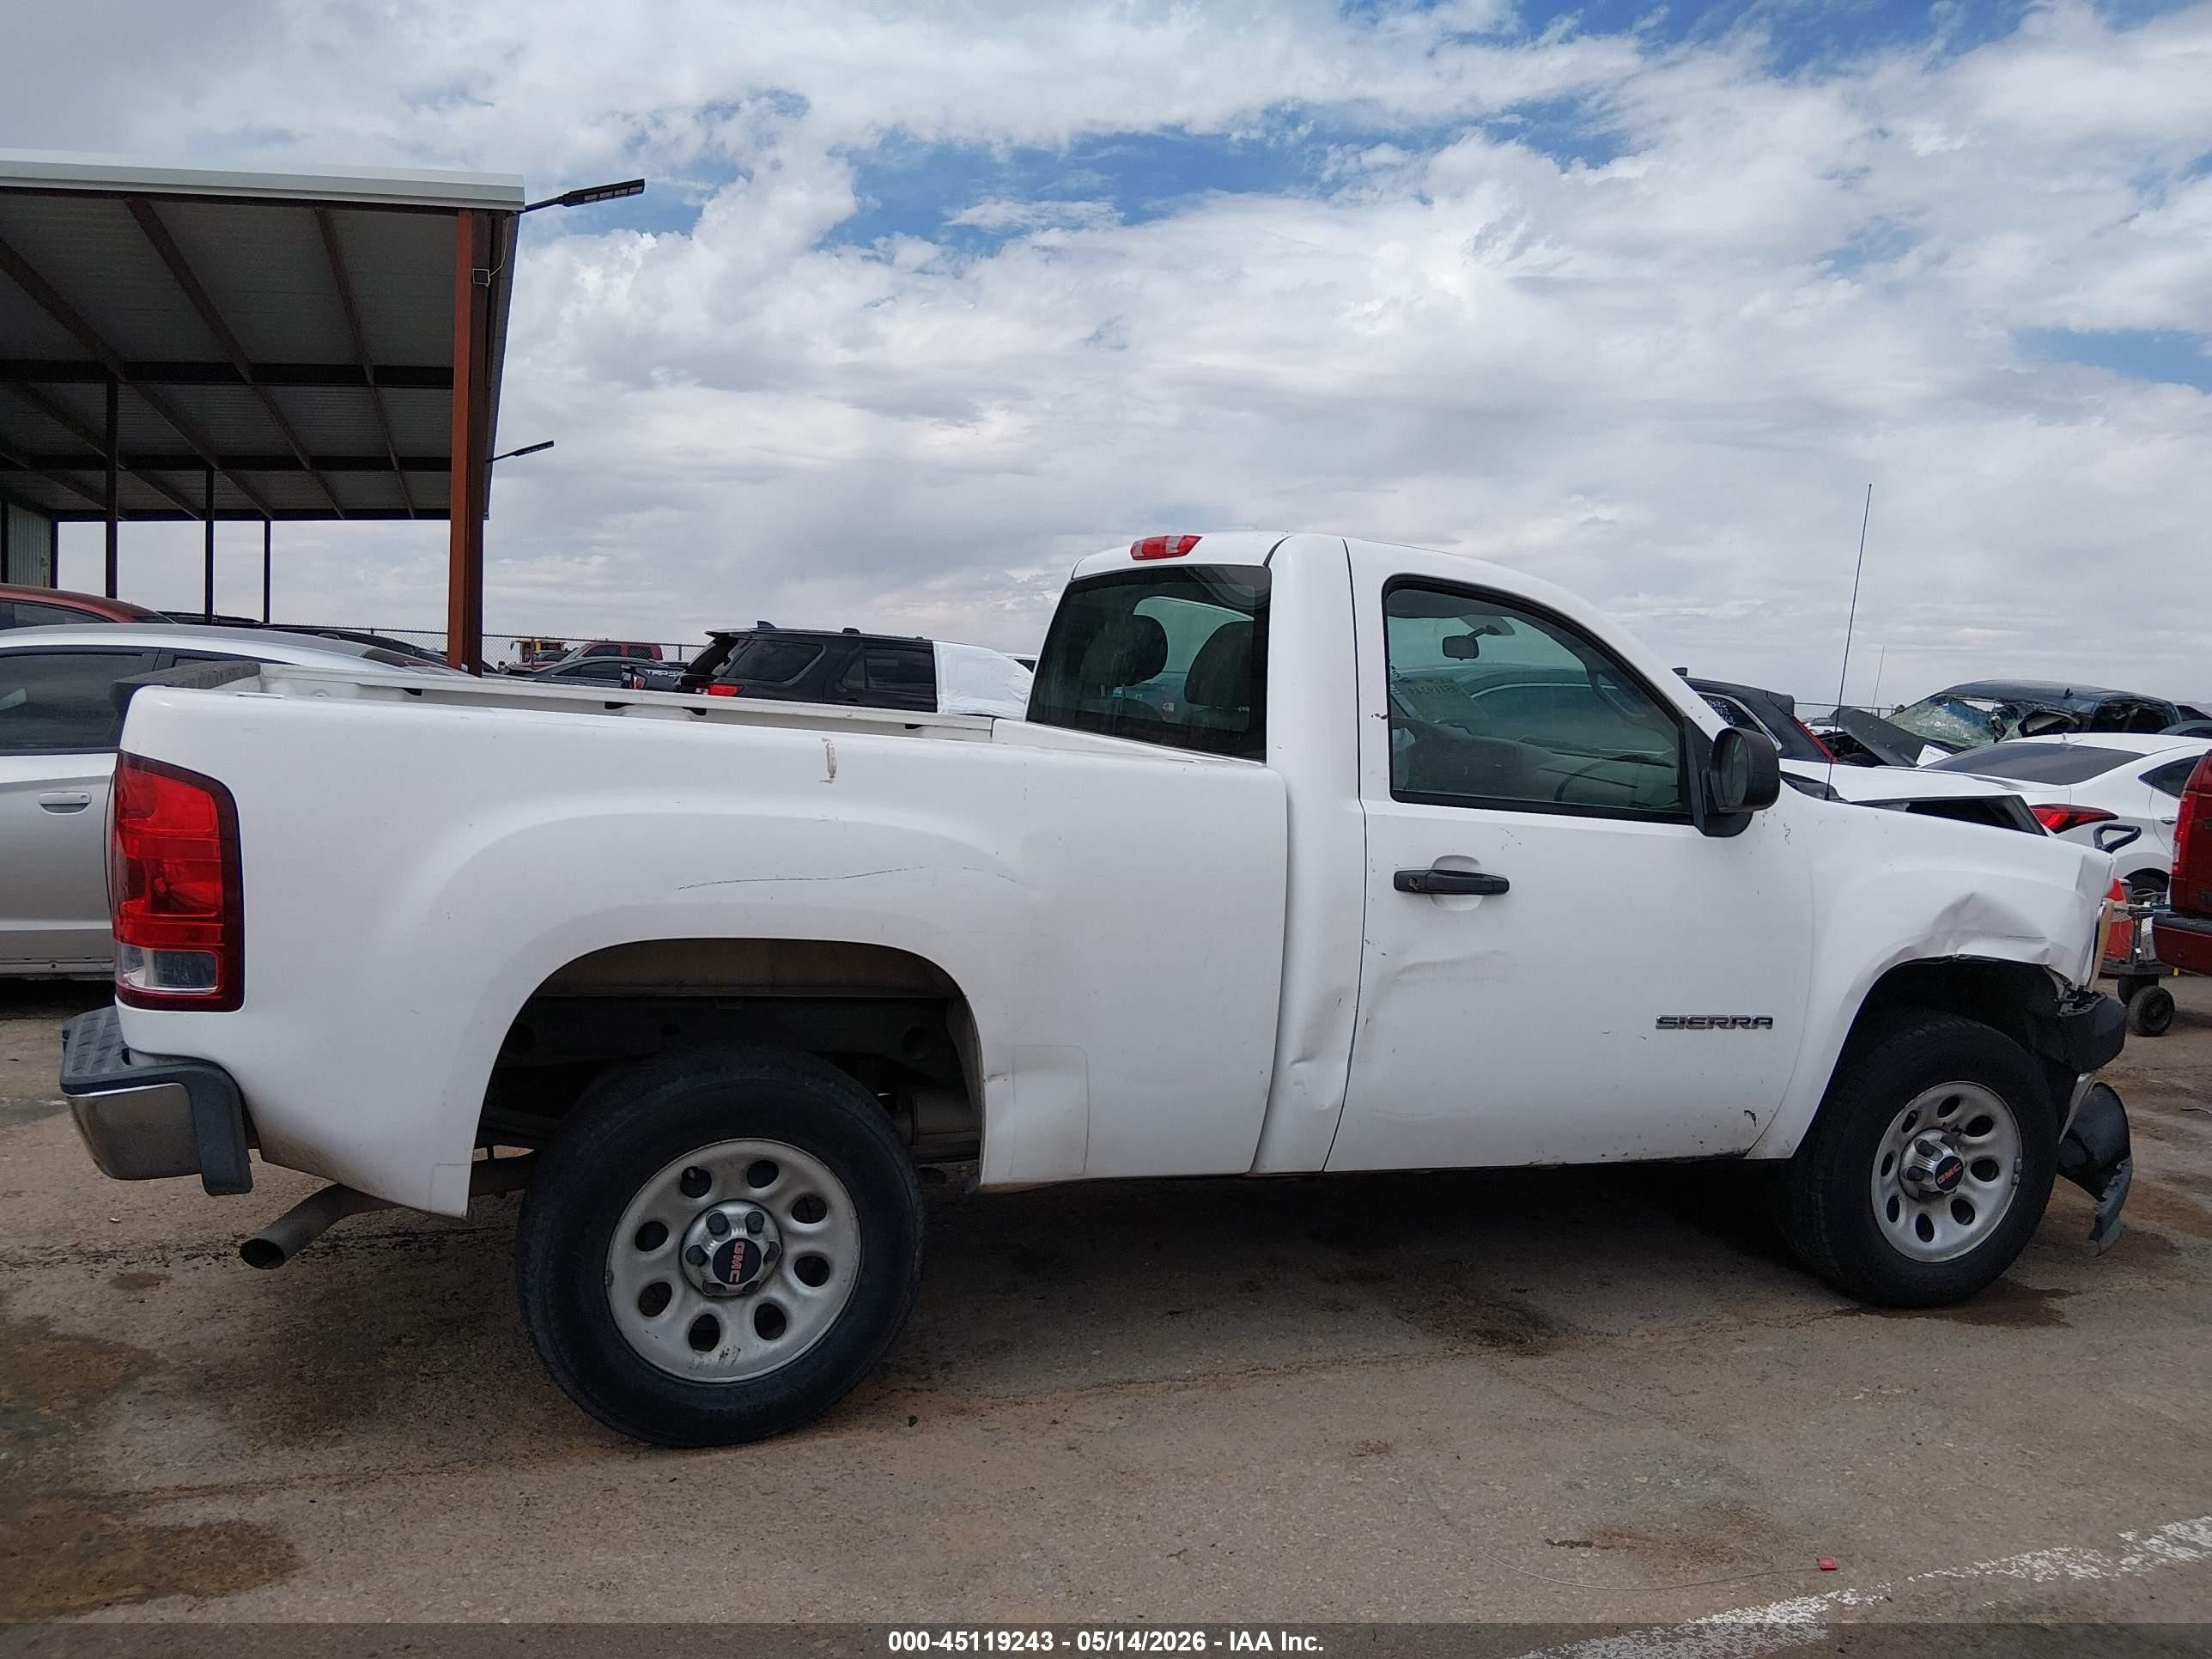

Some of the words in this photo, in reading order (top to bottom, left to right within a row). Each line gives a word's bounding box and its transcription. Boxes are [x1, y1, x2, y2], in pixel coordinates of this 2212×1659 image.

[1656, 1015, 1773, 1030] SIERRA
[1936, 1162, 1962, 1185] GMC
[729, 1241, 745, 1283] GMC
